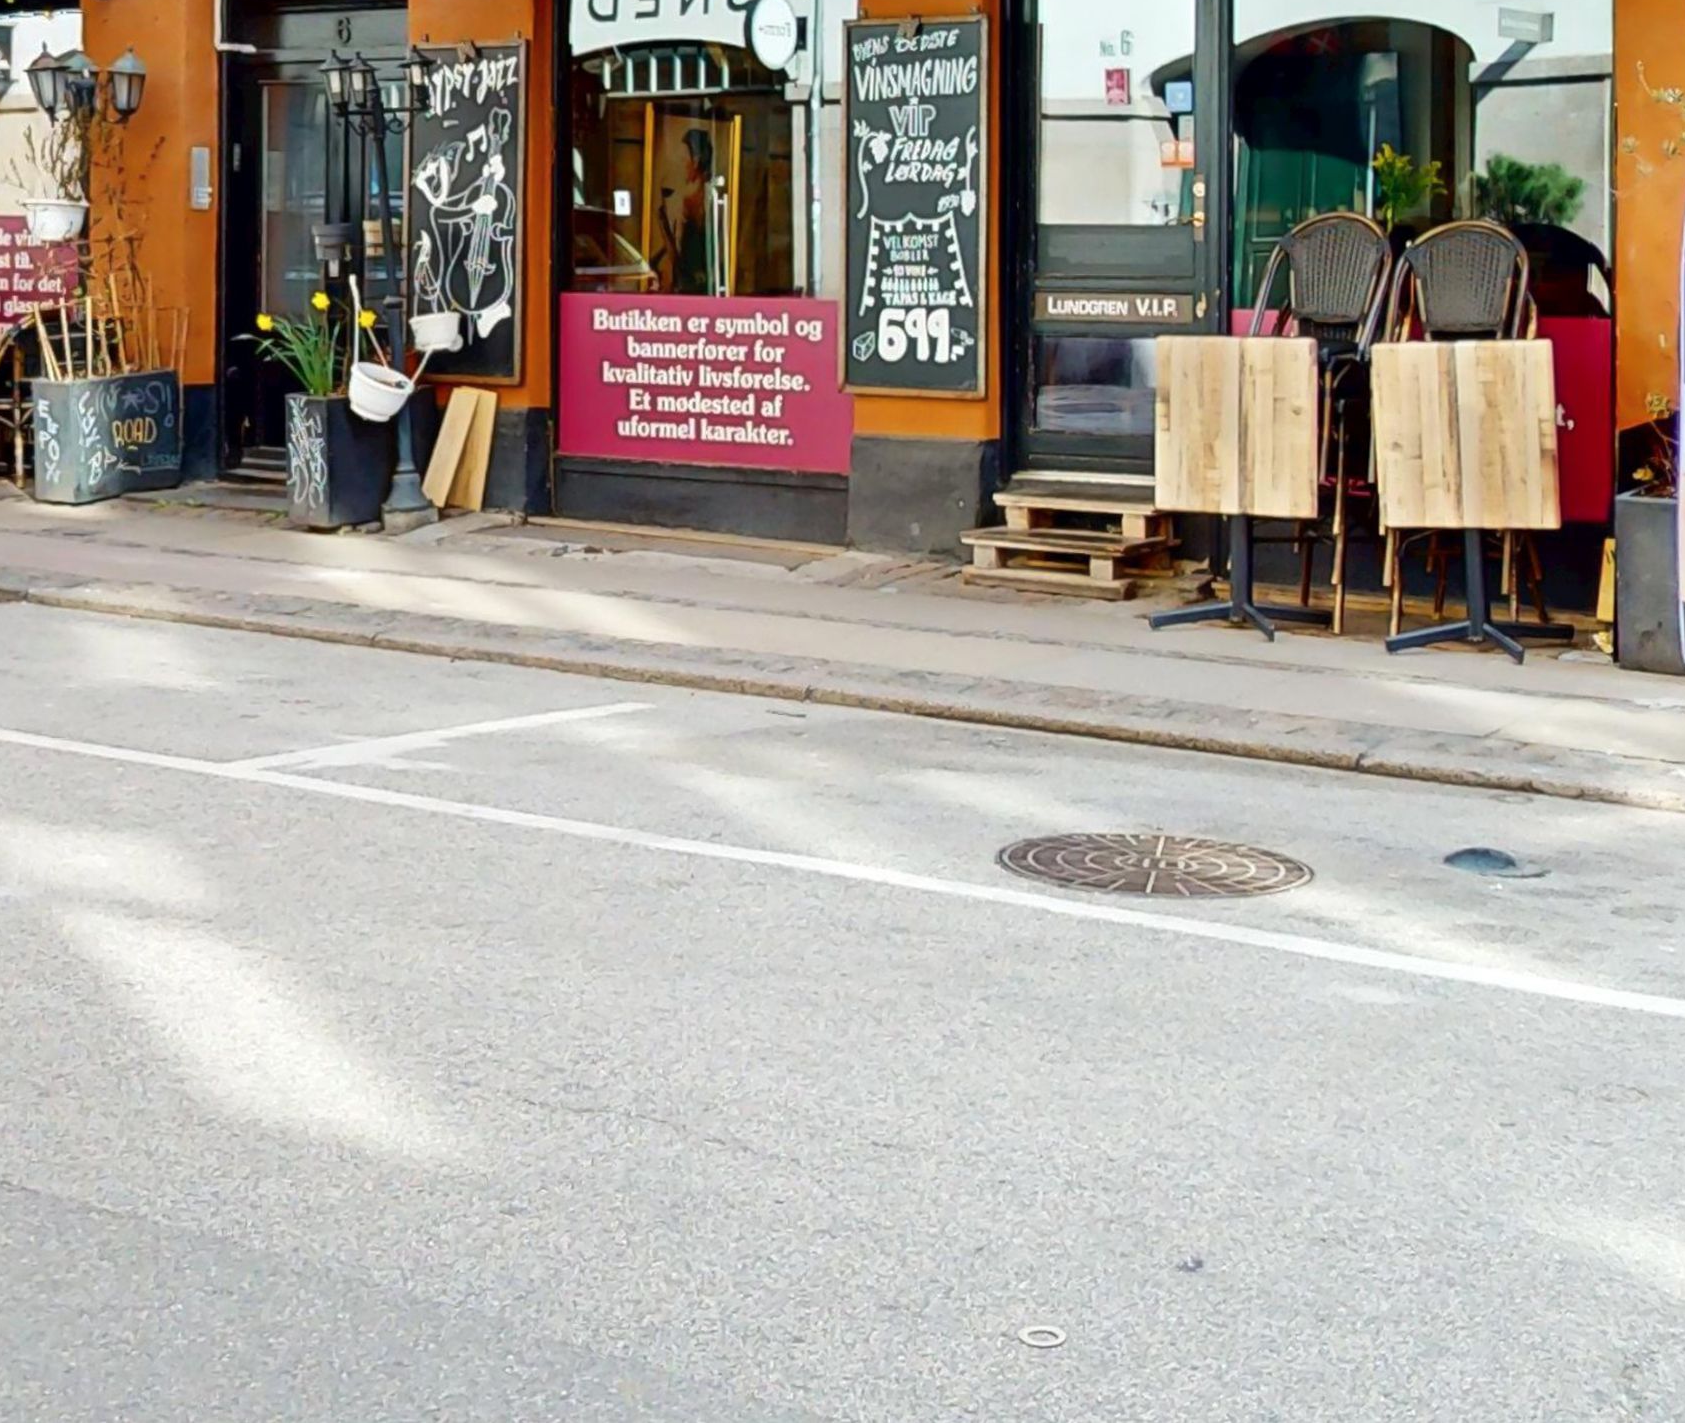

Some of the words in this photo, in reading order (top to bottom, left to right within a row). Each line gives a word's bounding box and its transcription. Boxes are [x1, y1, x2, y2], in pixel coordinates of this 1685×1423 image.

[1120, 30, 1134, 56] 6
[888, 103, 937, 137] VIP
[889, 135, 961, 161] FREDAG
[884, 160, 958, 189] LØRDAG
[882, 234, 939, 251] VELKOMST
[14, 250, 34, 270] til.
[13, 272, 34, 292] for
[1046, 295, 1129, 317] LUNDGREN
[1134, 297, 1179, 318] V.I.P.
[592, 307, 682, 333] Butikken
[686, 314, 710, 334] er
[714, 312, 790, 338] symbol
[794, 319, 823, 342] og
[877, 307, 951, 364] 699
[626, 335, 748, 363] bannerfører
[753, 339, 786, 364] for
[602, 360, 694, 388] kvalitativ
[698, 364, 811, 392] livsførelse.
[628, 388, 651, 411] Et
[656, 390, 755, 416] mødested
[760, 394, 784, 418] af
[617, 415, 696, 441] uformel
[700, 418, 795, 446] karakter.
